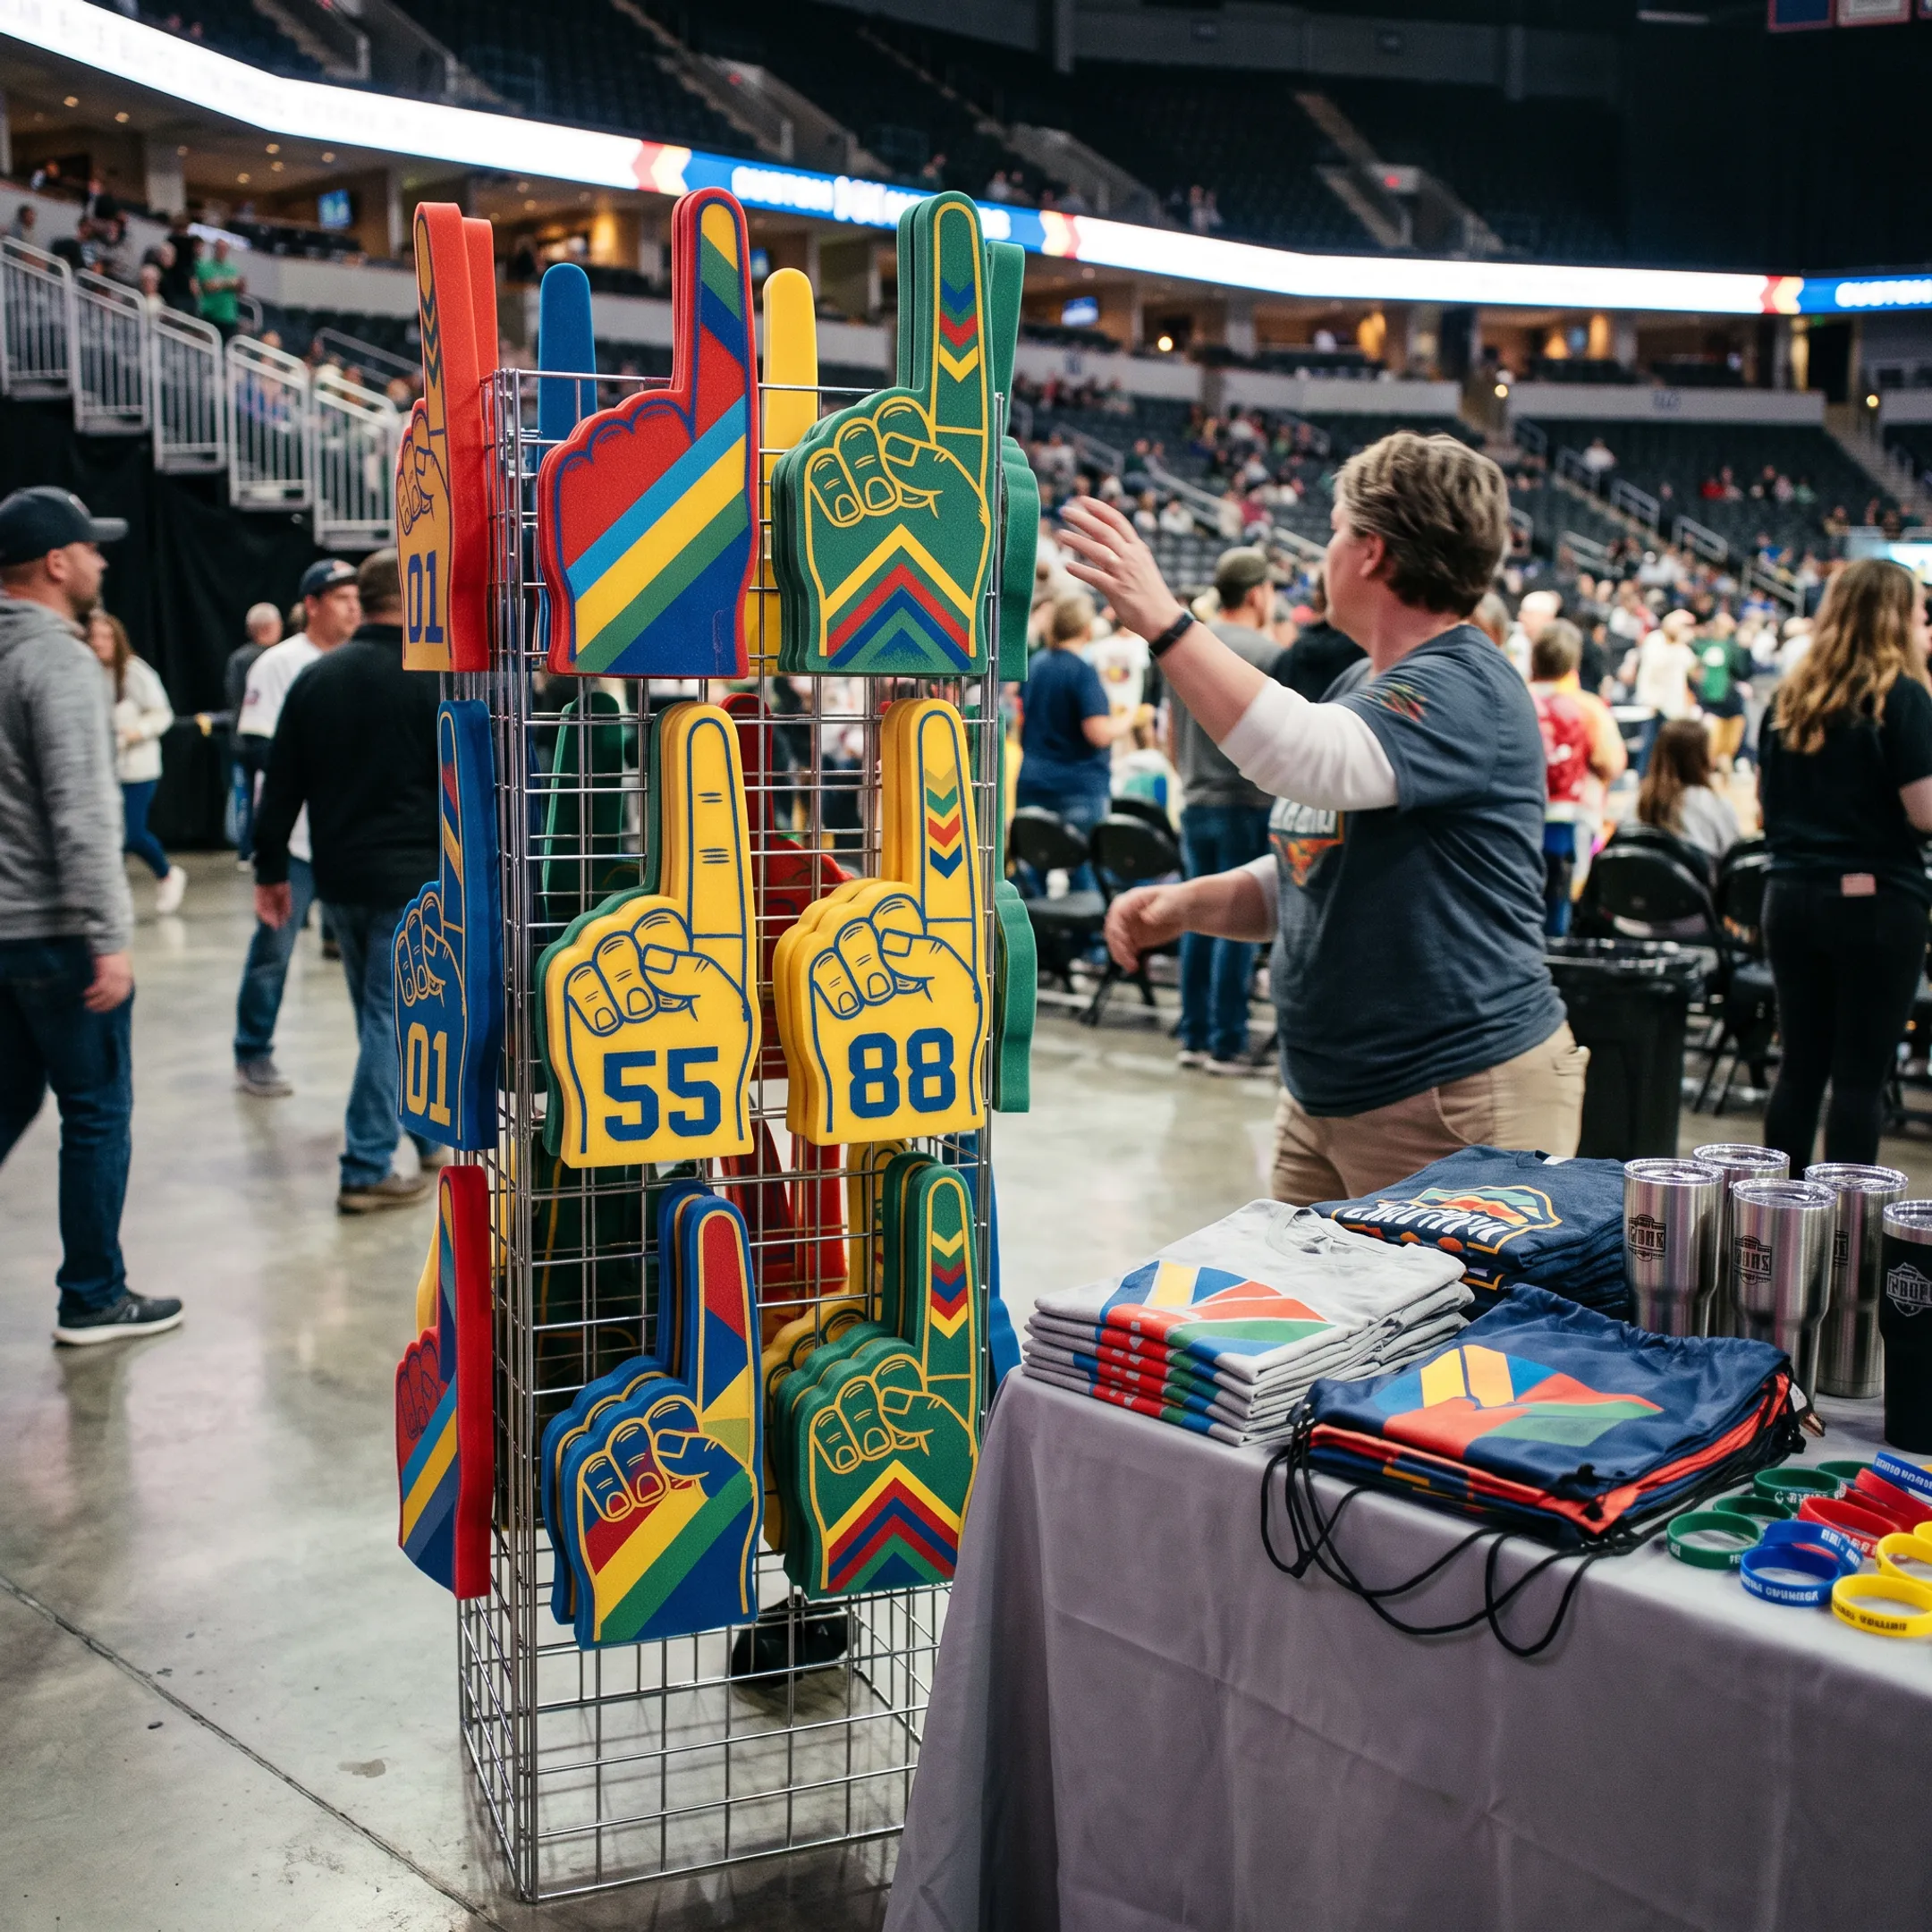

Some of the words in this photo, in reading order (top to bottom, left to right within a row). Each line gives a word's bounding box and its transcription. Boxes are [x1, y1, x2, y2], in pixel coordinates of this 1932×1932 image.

[407, 549, 444, 644] 01
[406, 1021, 451, 1127] 01
[603, 1046, 722, 1142] 55
[848, 1027, 956, 1119] 88
